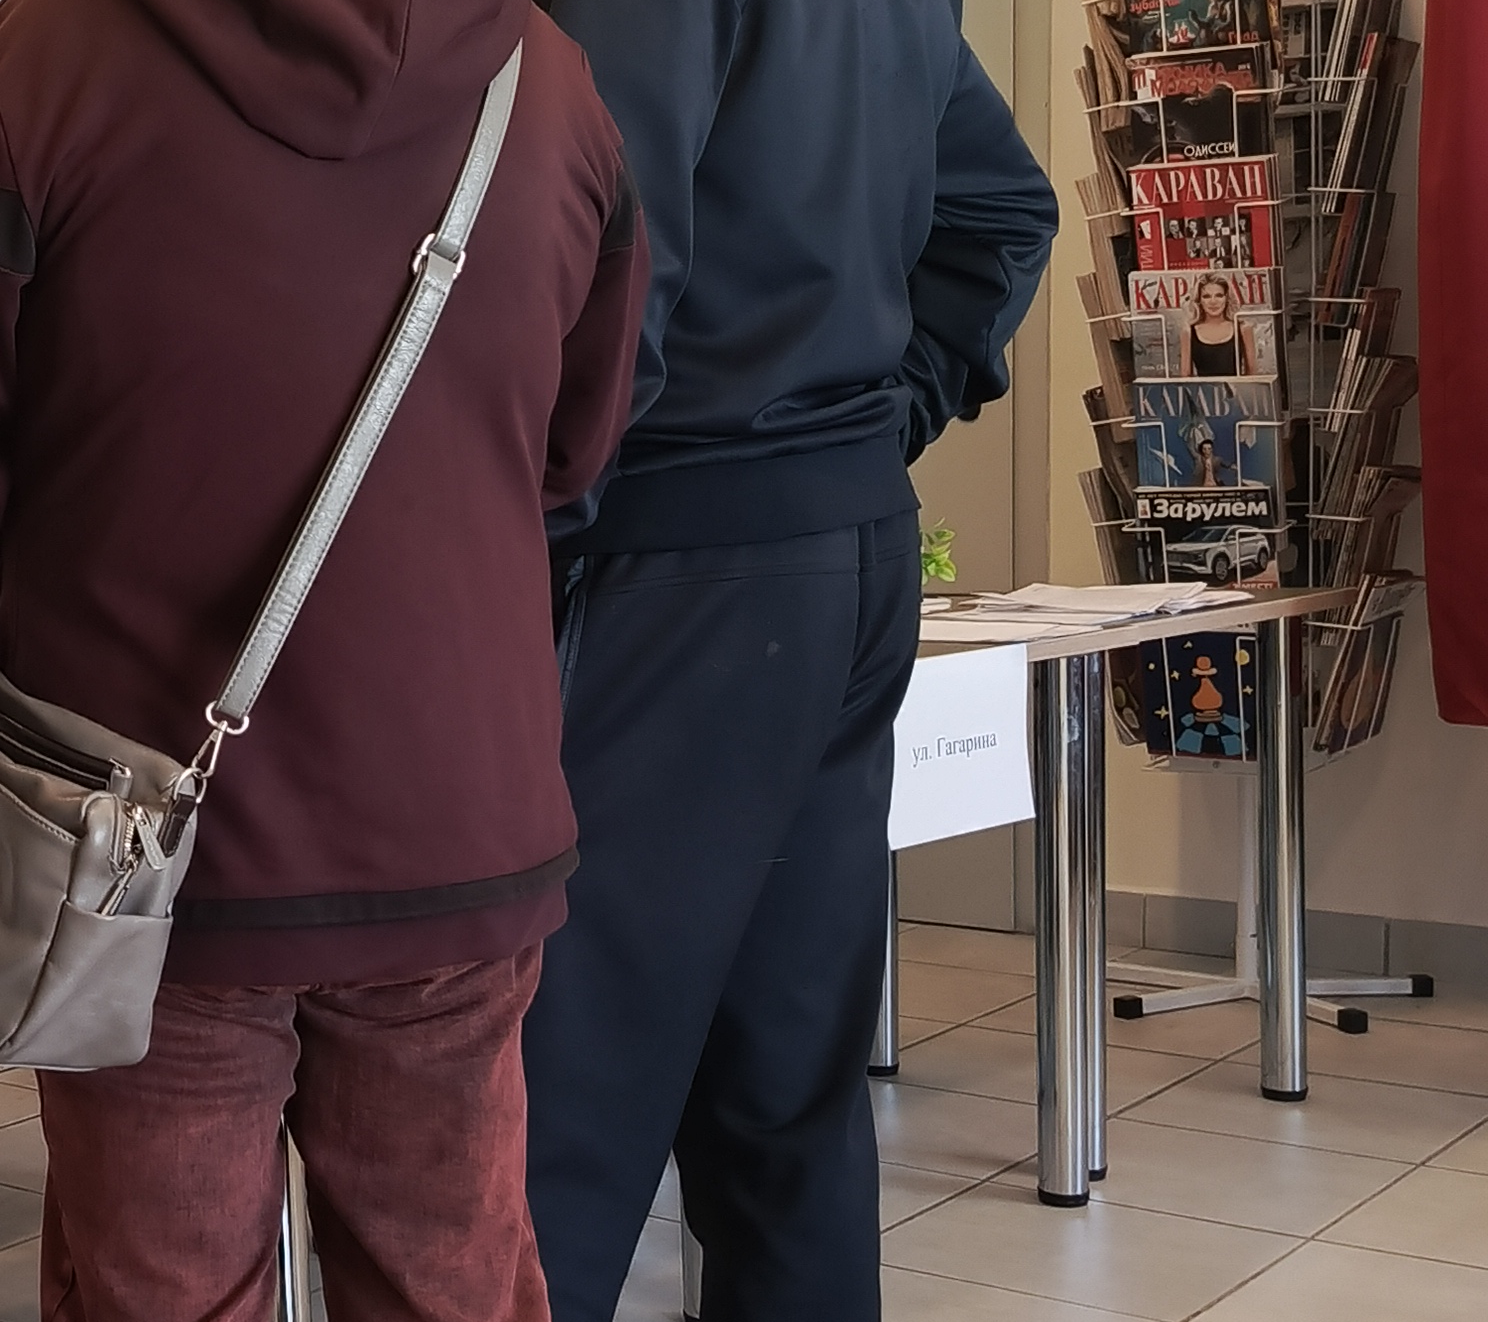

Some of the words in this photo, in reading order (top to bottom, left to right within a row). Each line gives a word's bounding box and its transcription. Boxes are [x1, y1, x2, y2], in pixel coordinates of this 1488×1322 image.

[1129, 164, 1264, 206] КАРАВАН
[1133, 273, 1266, 312] КАРАН
[912, 746, 933, 768] ул.
[936, 733, 998, 758] Гагарина
